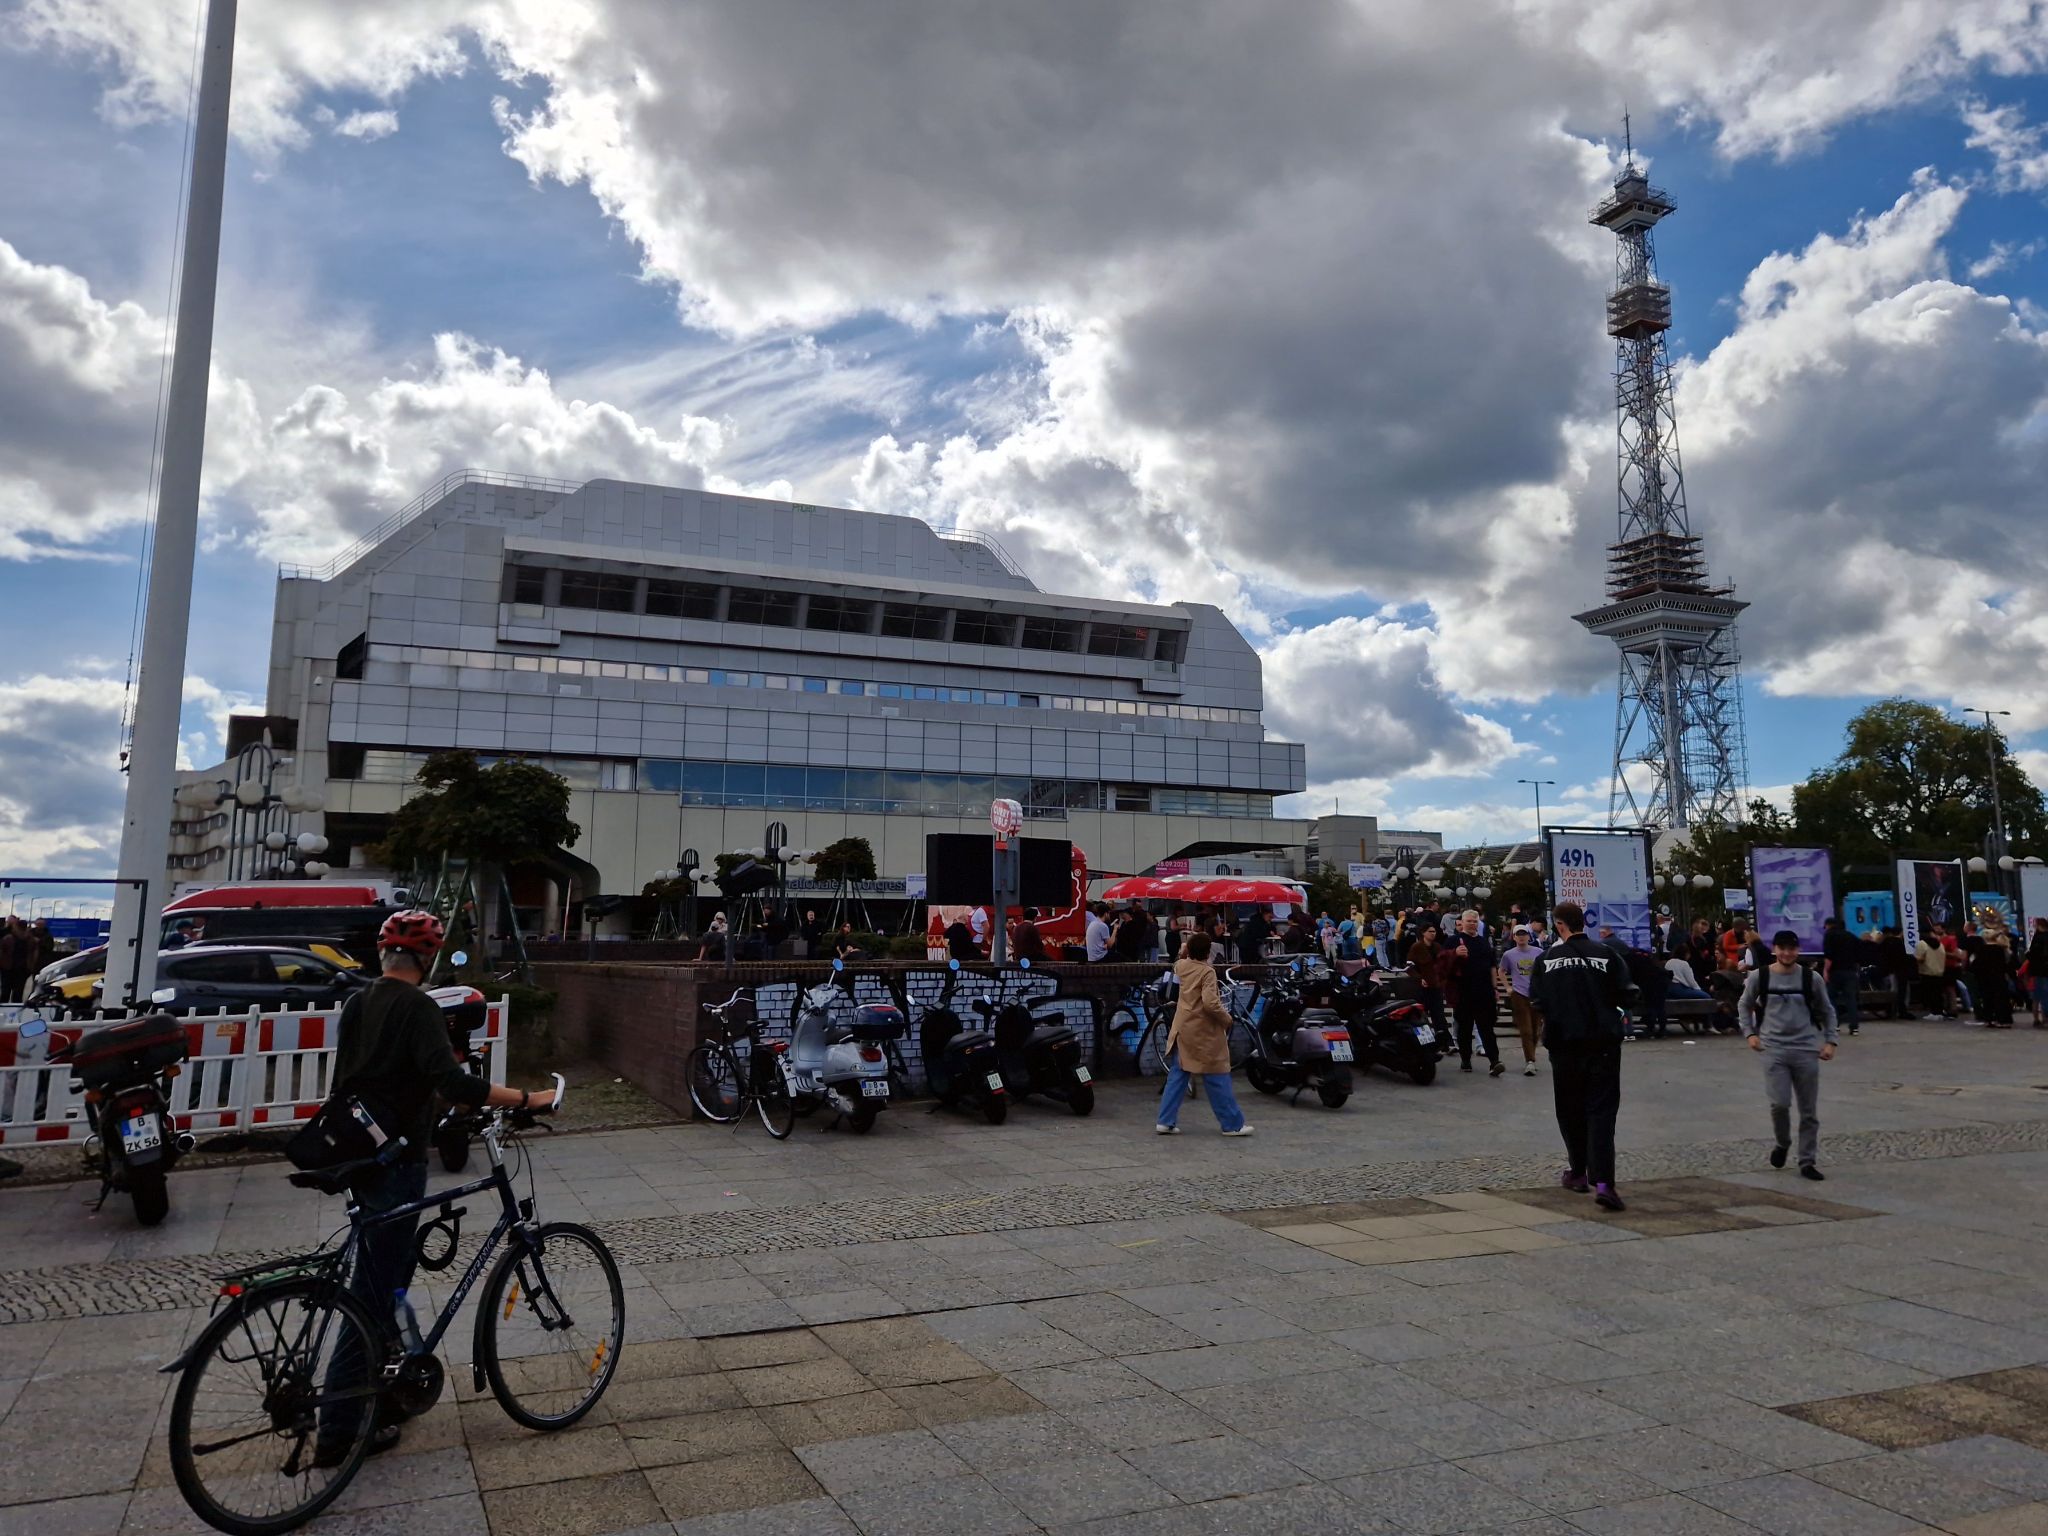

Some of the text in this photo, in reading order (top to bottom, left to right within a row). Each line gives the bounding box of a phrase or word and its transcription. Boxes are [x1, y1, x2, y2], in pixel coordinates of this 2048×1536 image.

[994, 805, 1010, 819] CURRY
[1560, 848, 1595, 868] 49h
[1560, 868, 1595, 878] TAG DES
[1561, 878, 1598, 888] OFFENEN
[1561, 888, 1584, 898] DENK
[1904, 891, 1917, 949] 49h ICC
[137, 1117, 146, 1127] B
[126, 1136, 160, 1153] ZK 56
